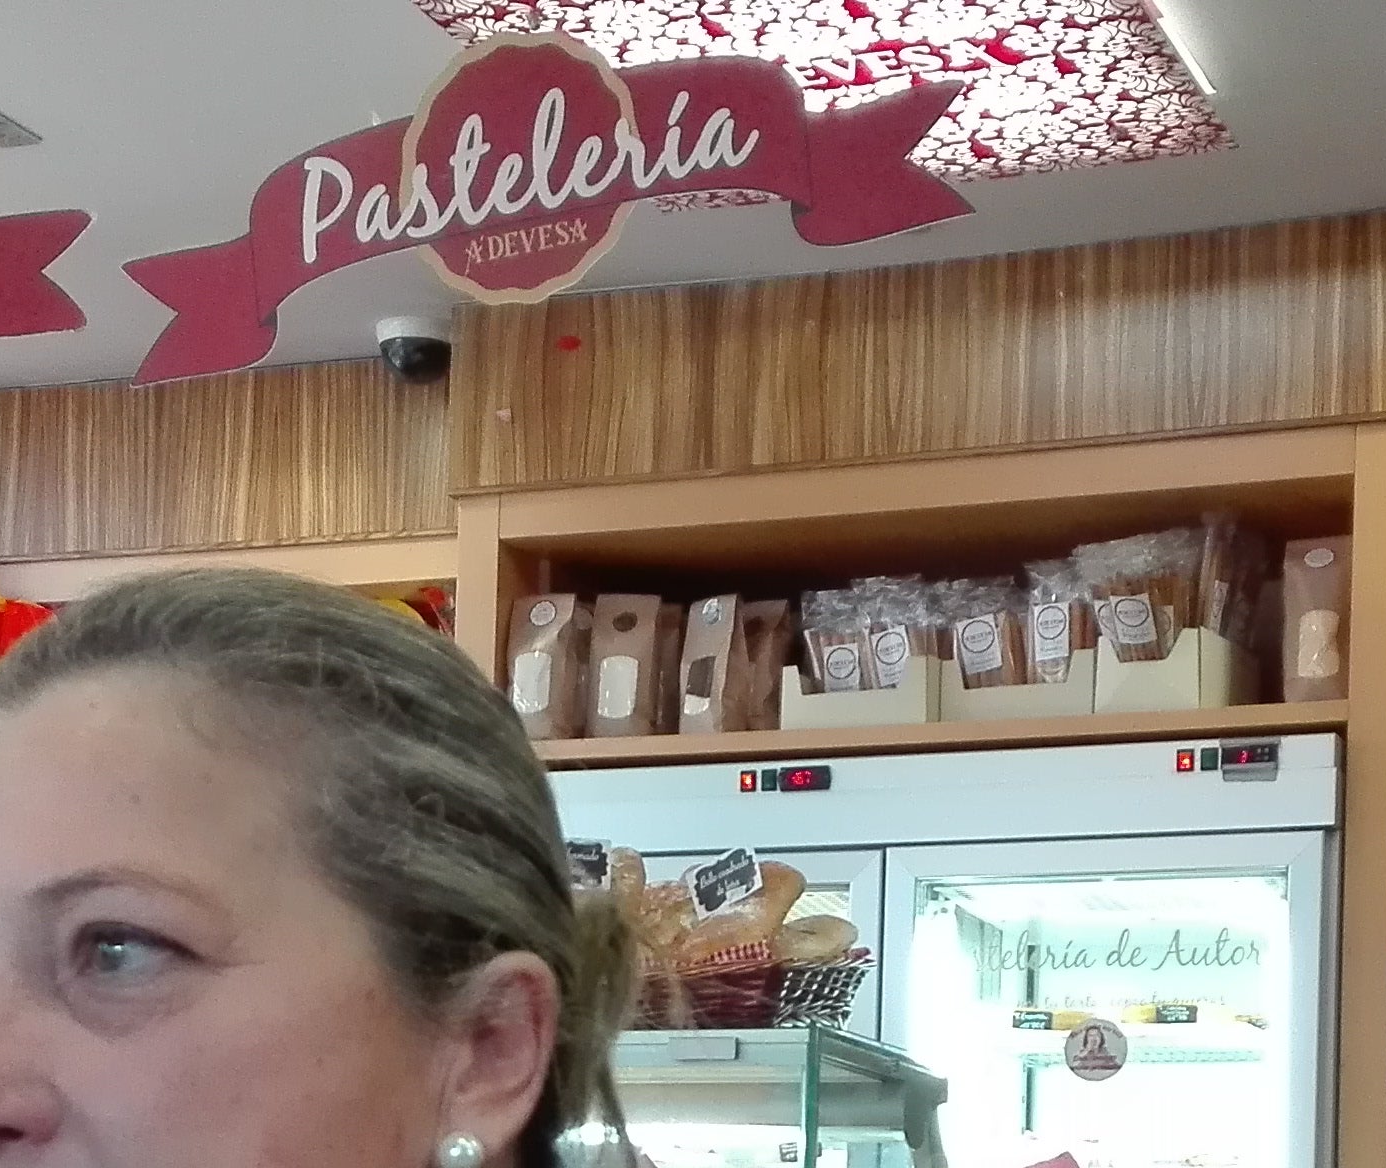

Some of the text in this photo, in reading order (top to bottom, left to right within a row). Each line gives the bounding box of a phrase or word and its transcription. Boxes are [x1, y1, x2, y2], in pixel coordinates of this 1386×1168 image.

[302, 86, 760, 264] Pastelería
[1106, 928, 1148, 969] de
[1151, 927, 1263, 972] Autor
